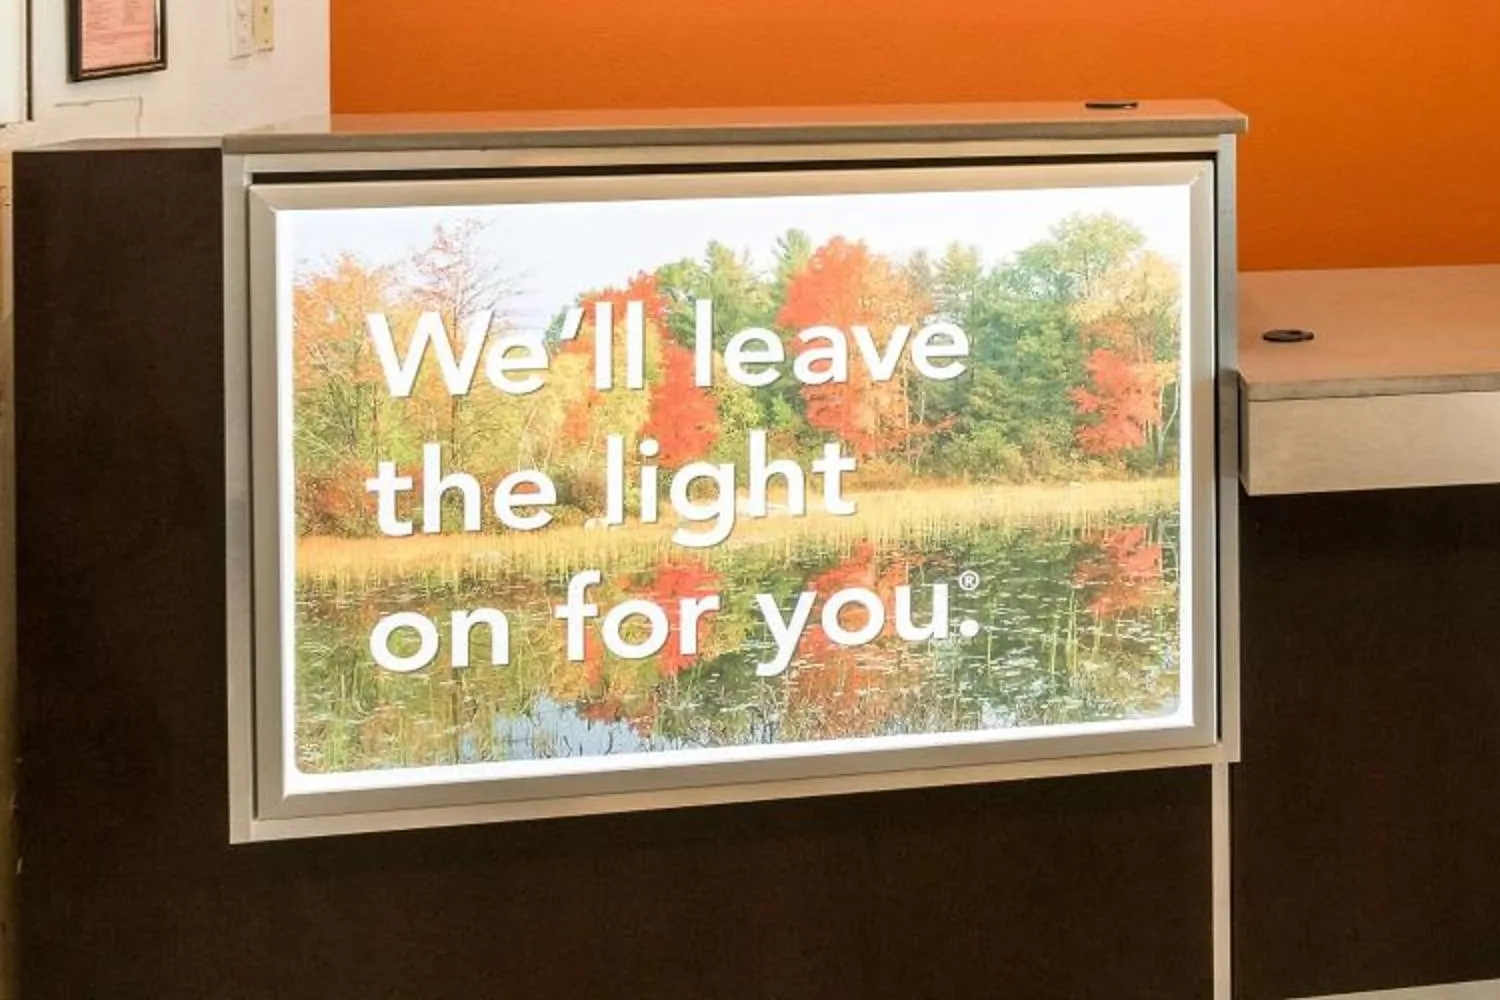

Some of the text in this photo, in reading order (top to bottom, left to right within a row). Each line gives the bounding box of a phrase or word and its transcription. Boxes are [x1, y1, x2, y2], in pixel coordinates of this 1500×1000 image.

[366, 299, 970, 398] We'll leave
[366, 429, 858, 548] the light
[369, 606, 510, 673] on
[554, 569, 721, 662] for
